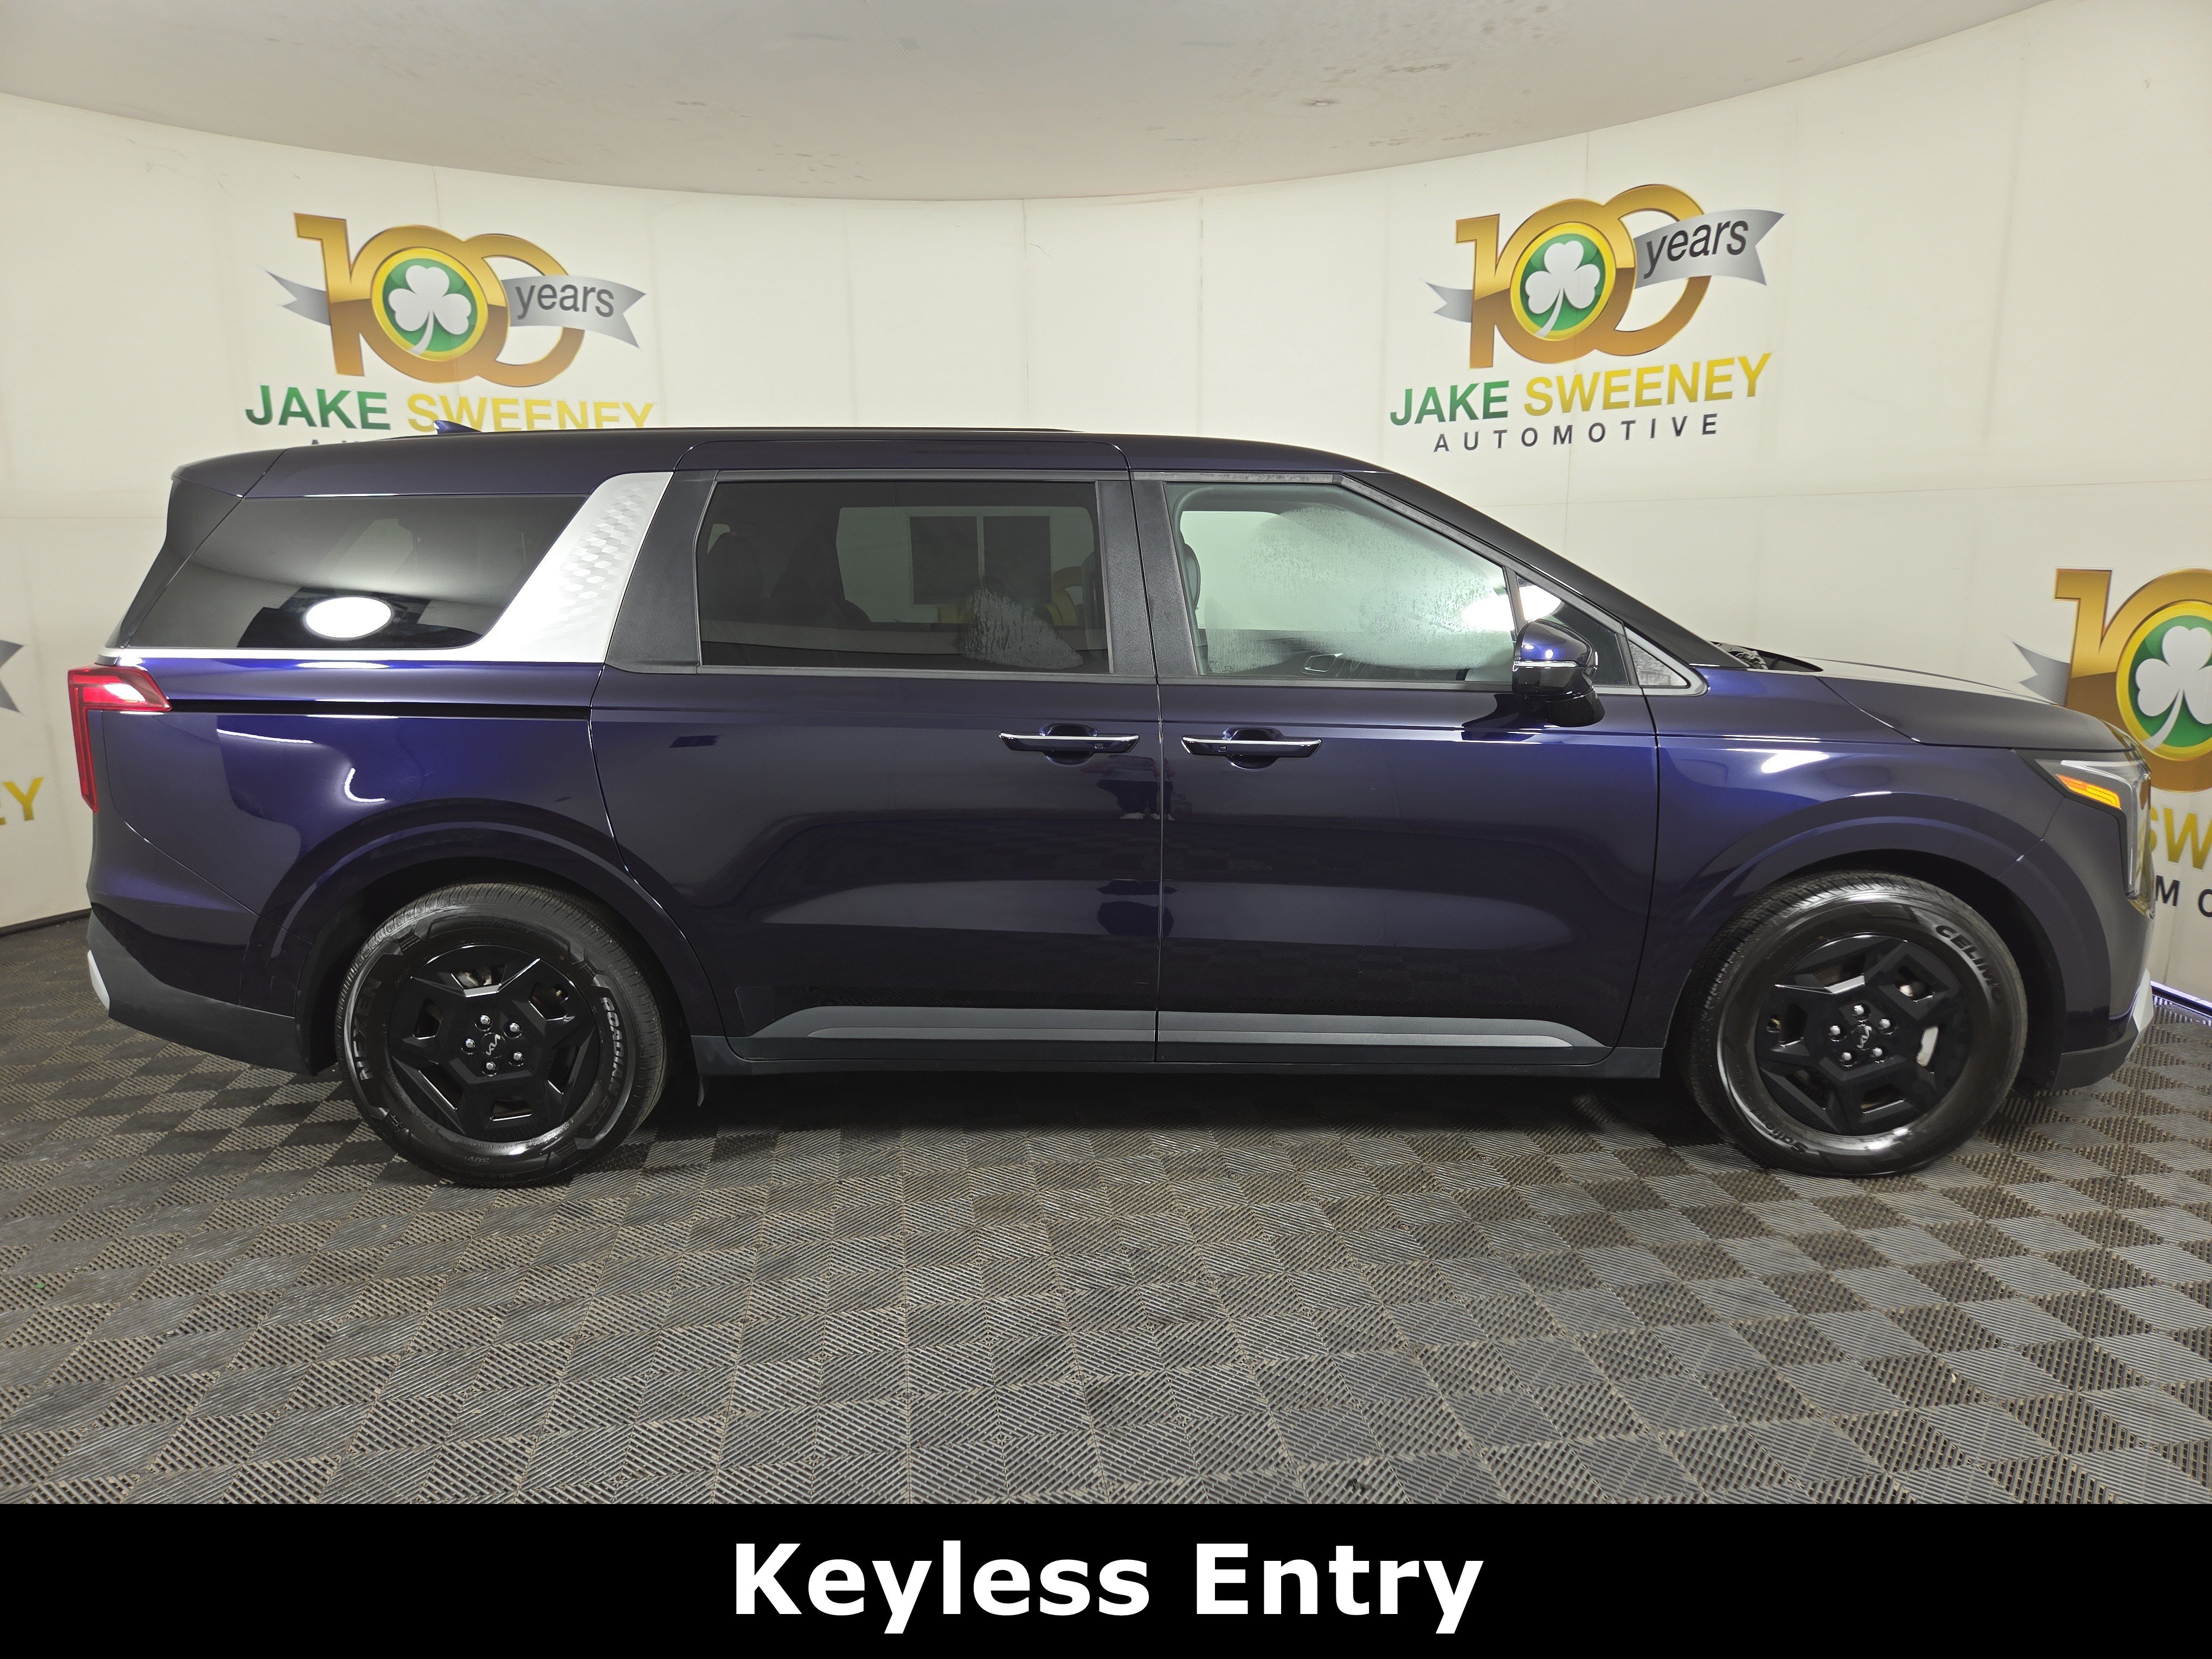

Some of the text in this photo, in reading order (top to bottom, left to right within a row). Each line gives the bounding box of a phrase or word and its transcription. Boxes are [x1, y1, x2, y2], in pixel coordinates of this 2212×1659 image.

[293, 212, 615, 387] 100 years
[1456, 184, 1748, 369] 100 years
[245, 384, 655, 432] JAKE SWEENEY
[1390, 352, 1772, 426] JAKE SWEENEY
[1433, 413, 1718, 453] AUTOMOTIVE
[353, 976, 382, 1081] NEXEN
[599, 996, 625, 1097] ROADIAN
